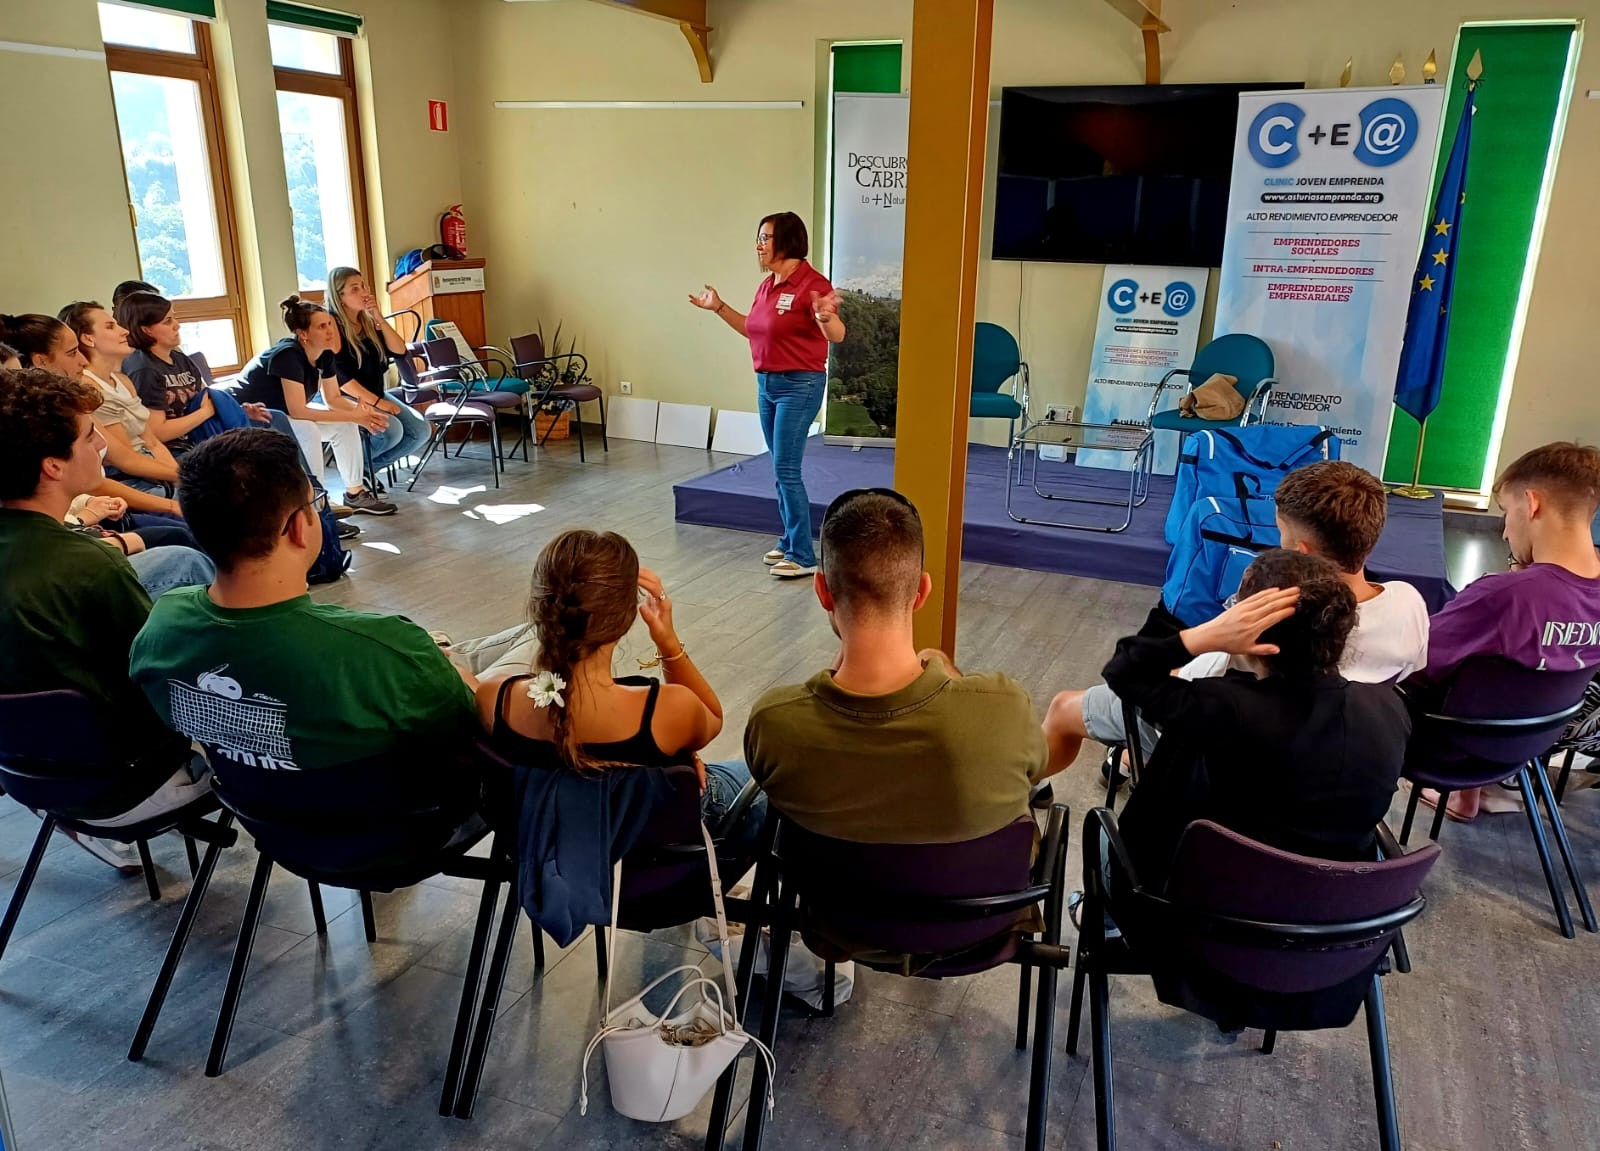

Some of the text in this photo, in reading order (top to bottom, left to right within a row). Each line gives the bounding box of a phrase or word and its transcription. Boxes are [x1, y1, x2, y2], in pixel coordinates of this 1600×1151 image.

[848, 152, 908, 169] DESCUBR
[855, 165, 908, 188] CABR
[1263, 177, 1385, 186] CLINIC JOVEN EMPRENDA
[1264, 192, 1380, 203] www.asturiasemprenda.org
[1246, 212, 1399, 222] ALTO RENDIMIENTO EMPRENDEDOR
[1273, 238, 1361, 248] EMPRENDEDORES
[1290, 247, 1340, 256] SOCIALES
[1252, 264, 1375, 276] INTRA-EMPRENDEDORES
[1267, 283, 1354, 294] EMPRENDEDORES
[1268, 292, 1351, 302] EMPRESARIALES
[1274, 391, 1342, 405] RENDIMIENTO
